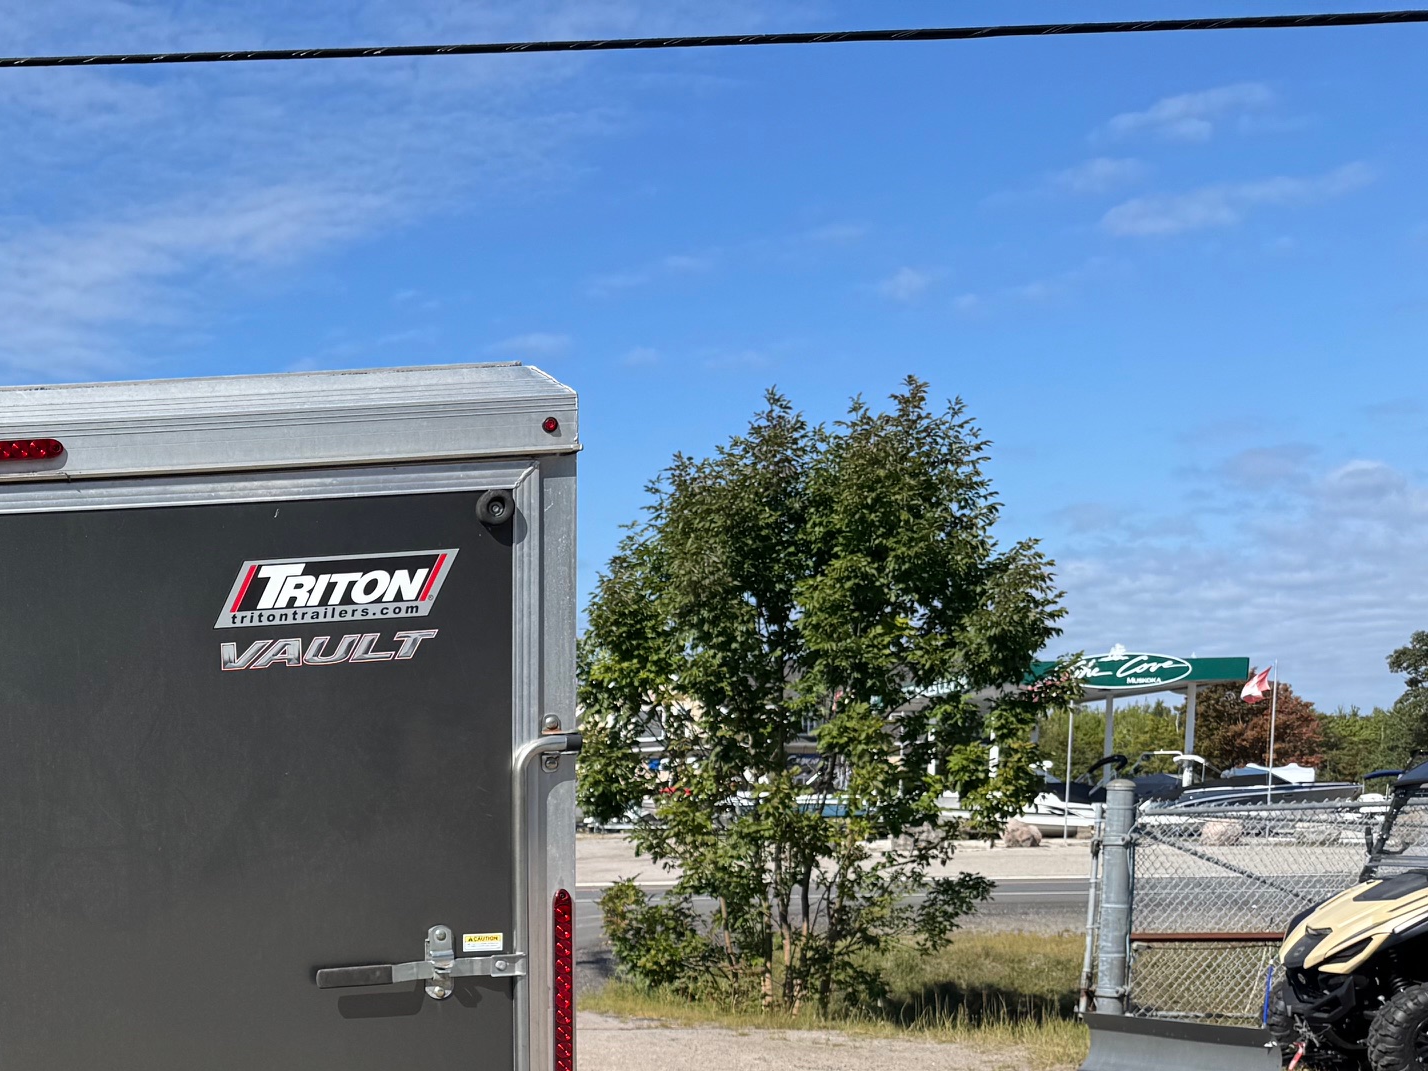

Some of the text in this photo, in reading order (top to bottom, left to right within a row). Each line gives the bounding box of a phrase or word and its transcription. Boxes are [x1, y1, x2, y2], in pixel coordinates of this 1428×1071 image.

[256, 563, 429, 609] TRITON
[231, 604, 419, 625] tritontrailers.com
[220, 629, 439, 671] VAULT
[1116, 656, 1187, 678] Cove
